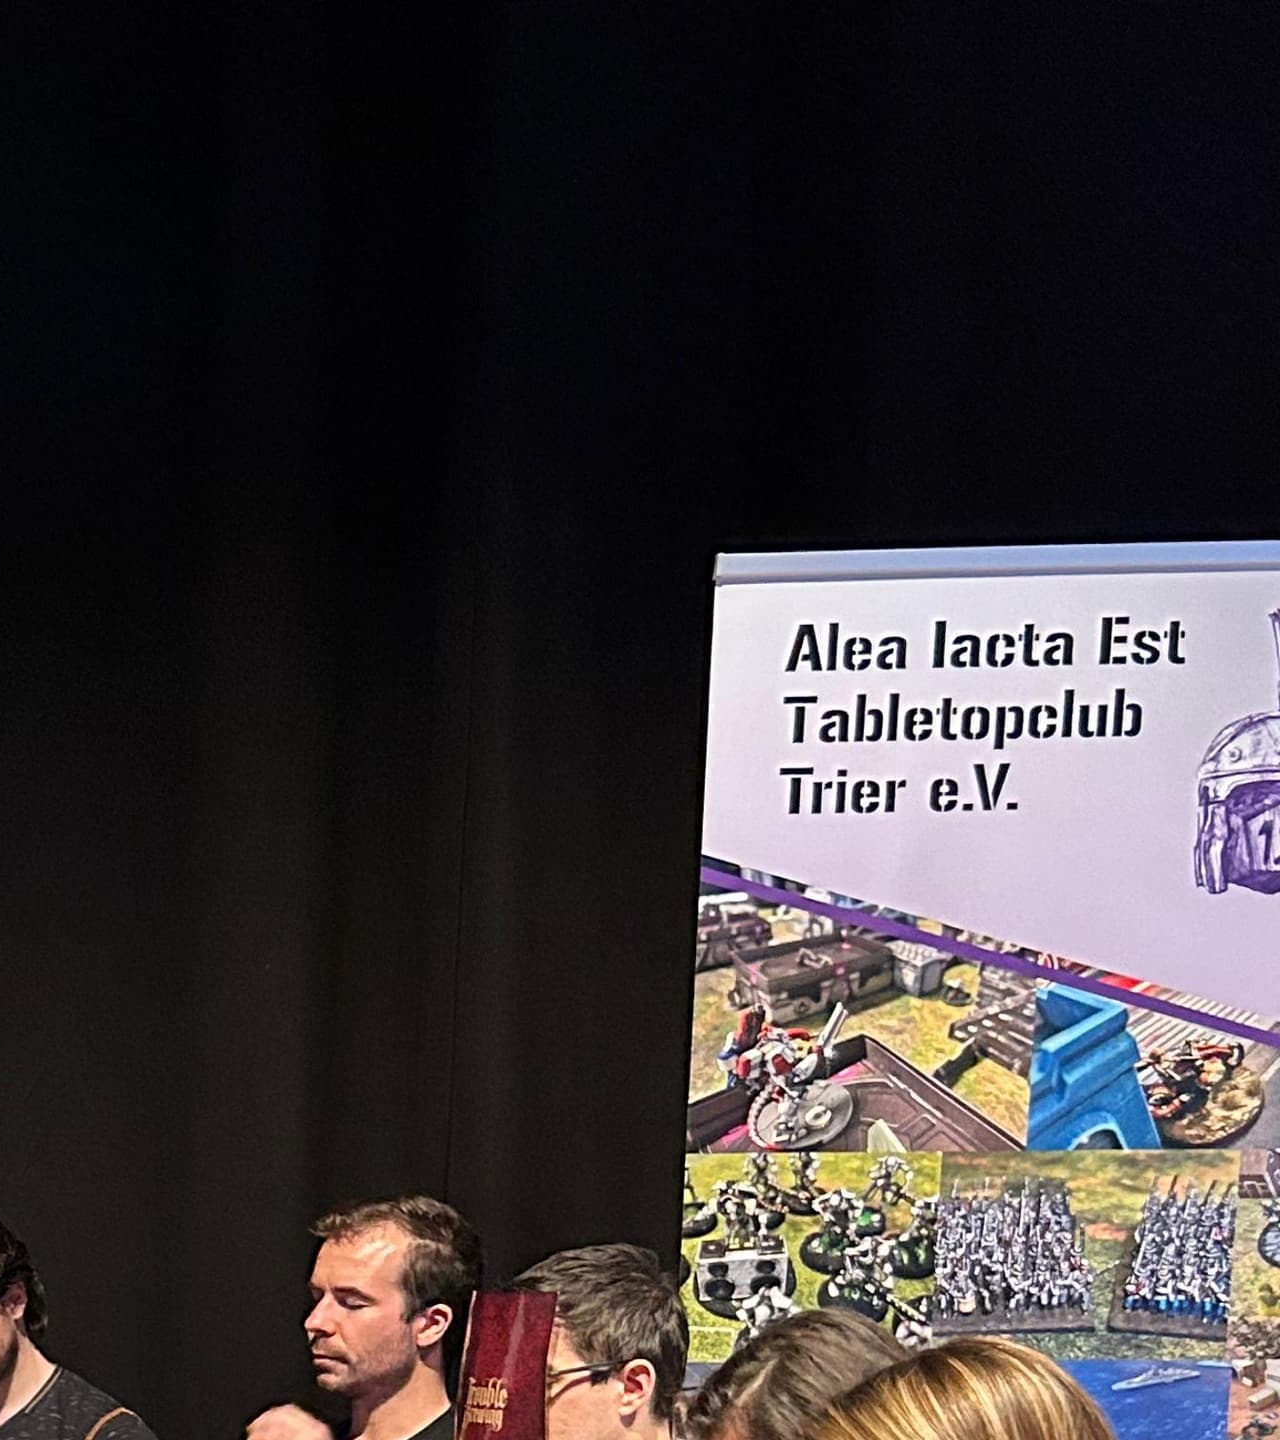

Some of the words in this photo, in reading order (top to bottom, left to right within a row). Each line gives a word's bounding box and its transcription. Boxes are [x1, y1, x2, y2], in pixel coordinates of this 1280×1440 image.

[784, 622, 907, 672] Alea
[931, 620, 1074, 668] Iacta
[1098, 616, 1186, 666] Est
[783, 689, 1142, 749] Tabletopclub
[780, 767, 906, 814] Trier
[928, 763, 1018, 812] e.V.
